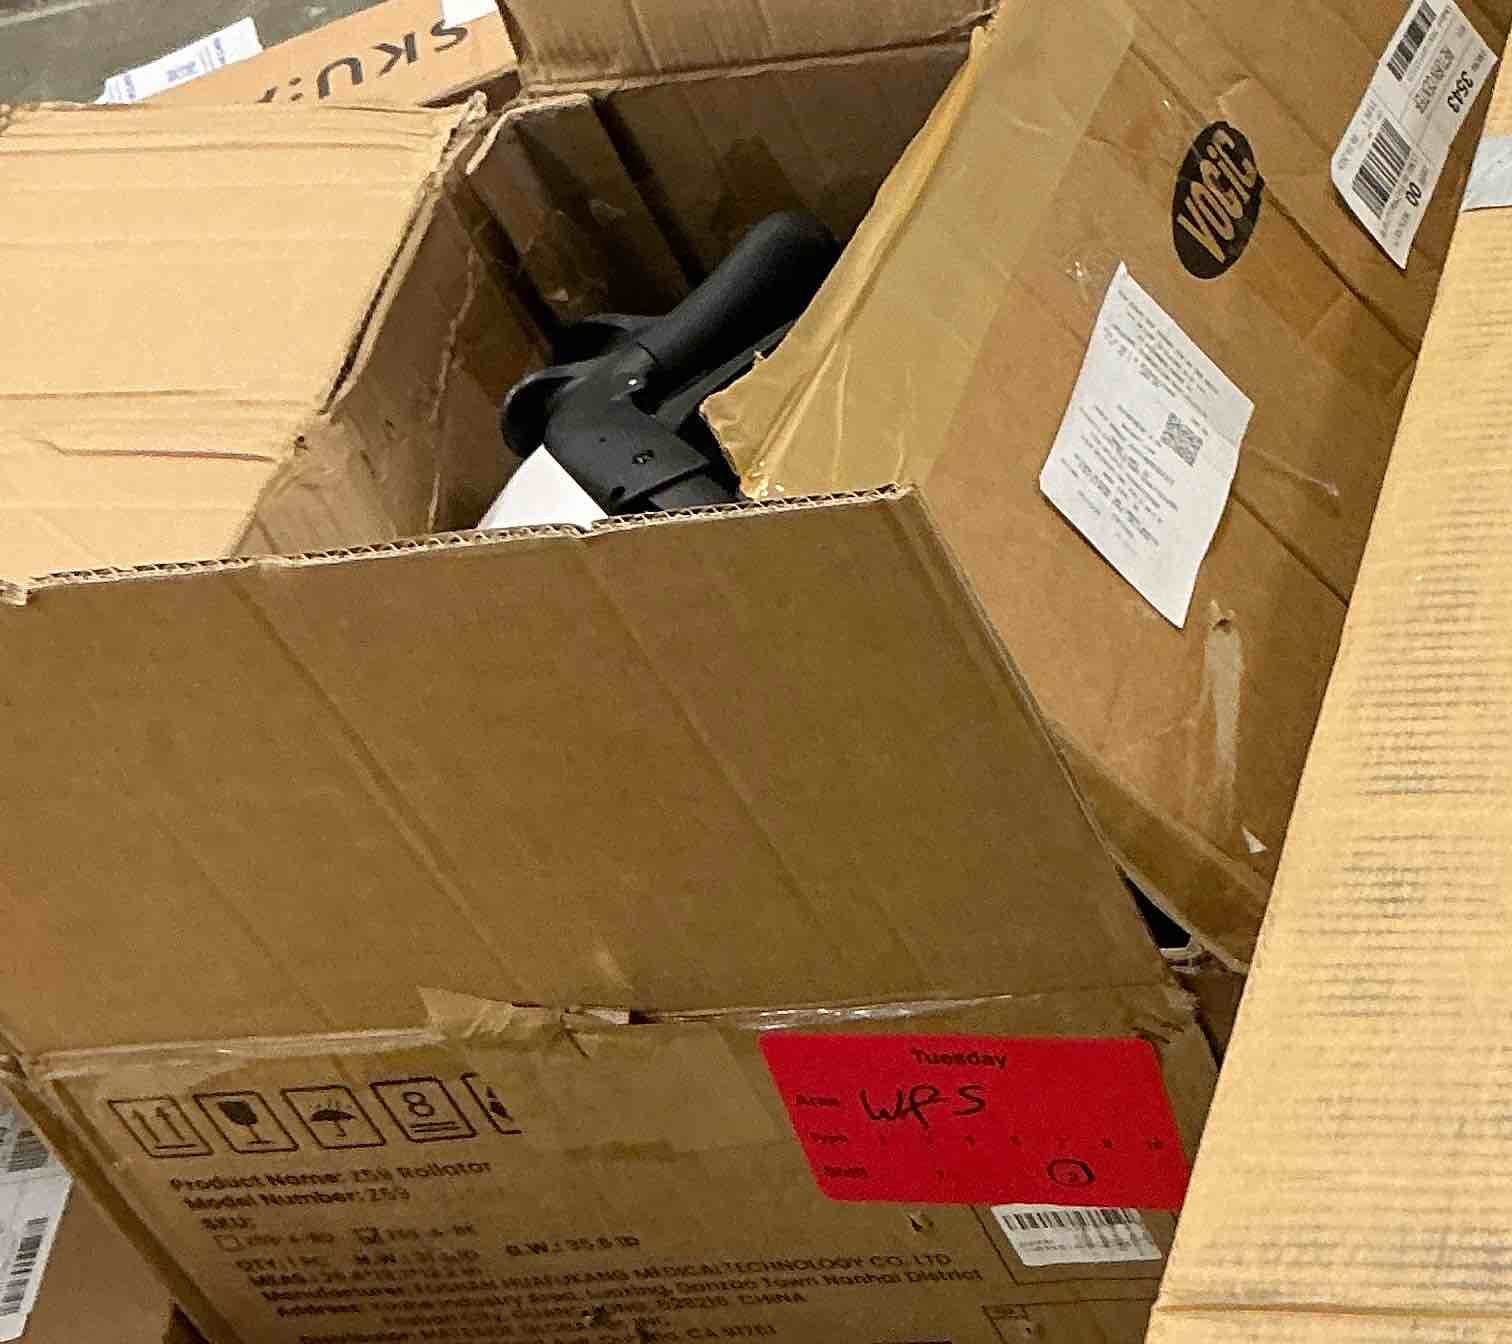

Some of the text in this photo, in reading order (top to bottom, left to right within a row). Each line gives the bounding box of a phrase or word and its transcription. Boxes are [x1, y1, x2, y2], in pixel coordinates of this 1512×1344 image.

[1447, 69, 1475, 114] 3543
[911, 1047, 1007, 1069] Tuesday
[396, 1161, 492, 1180] Rollator
